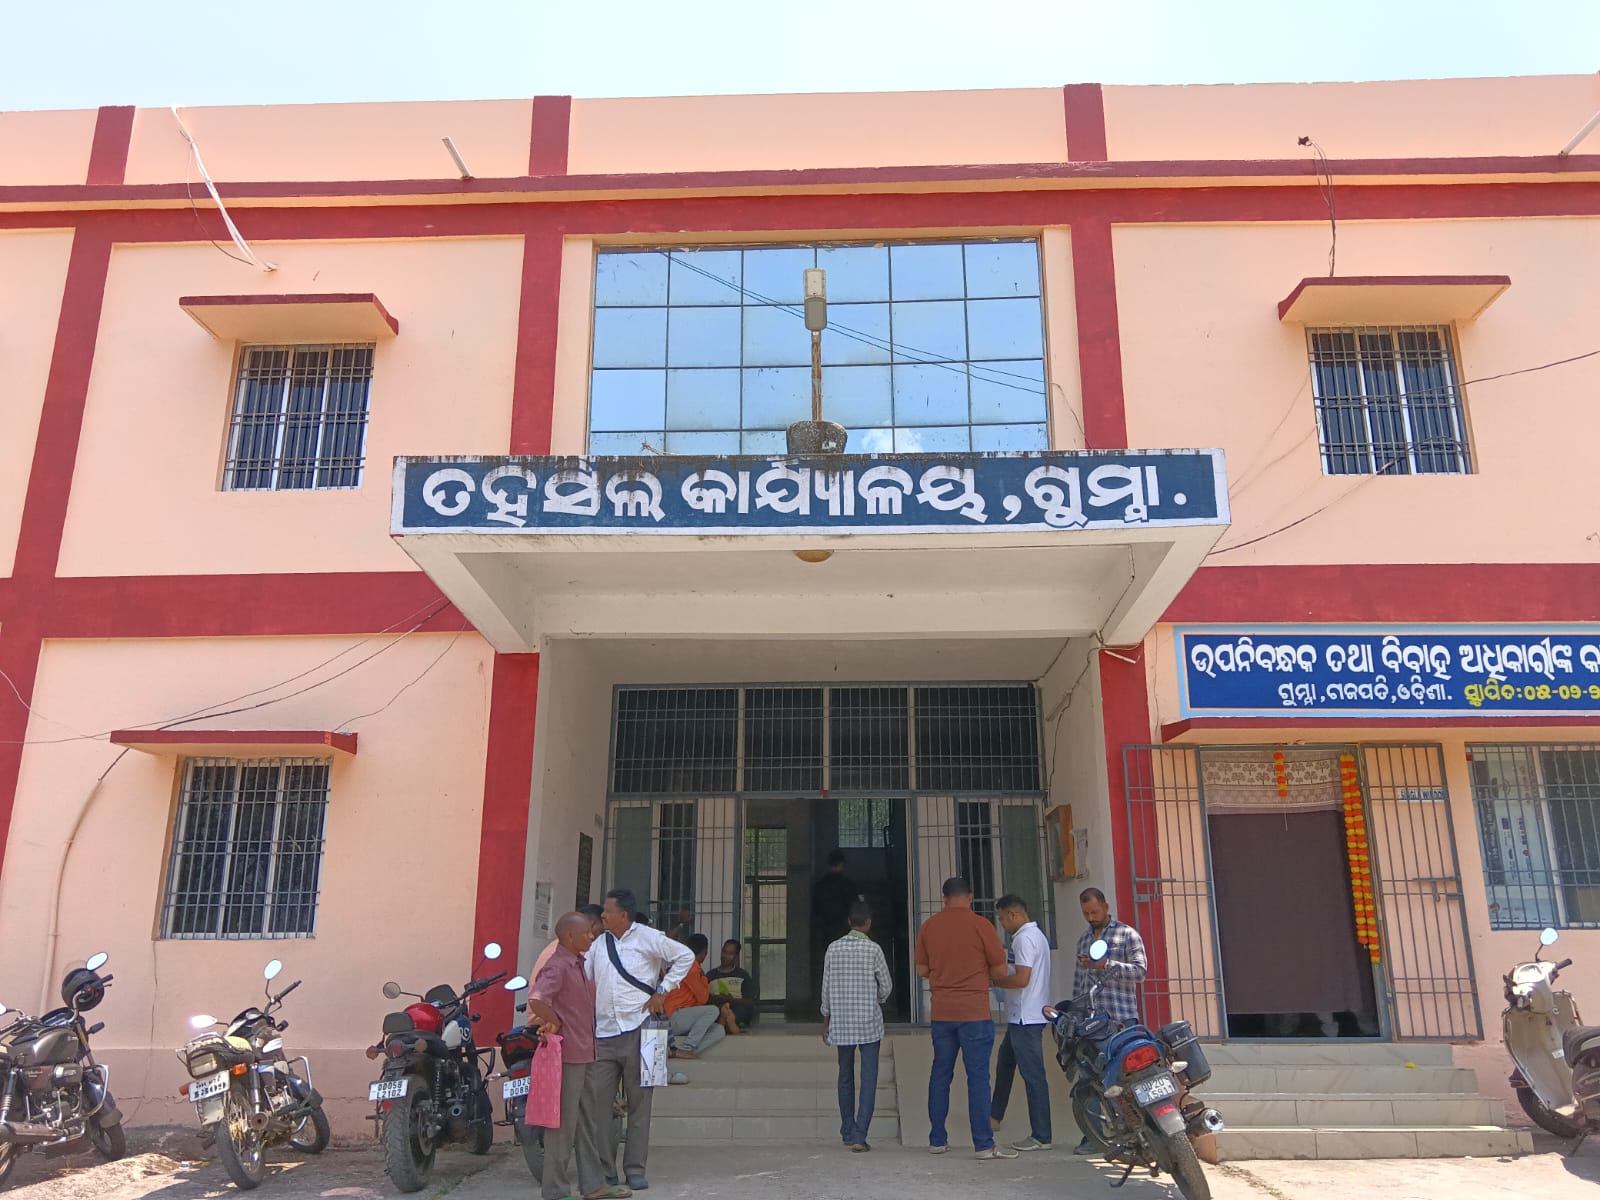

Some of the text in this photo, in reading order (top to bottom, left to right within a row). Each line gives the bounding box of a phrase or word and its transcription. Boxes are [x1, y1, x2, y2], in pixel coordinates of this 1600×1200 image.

[1191, 635, 1600, 682] ଉପନିବନ୍ଧକ ତଥା ବିବାହ ଅଧିକାରୀଙ୍କ କ
